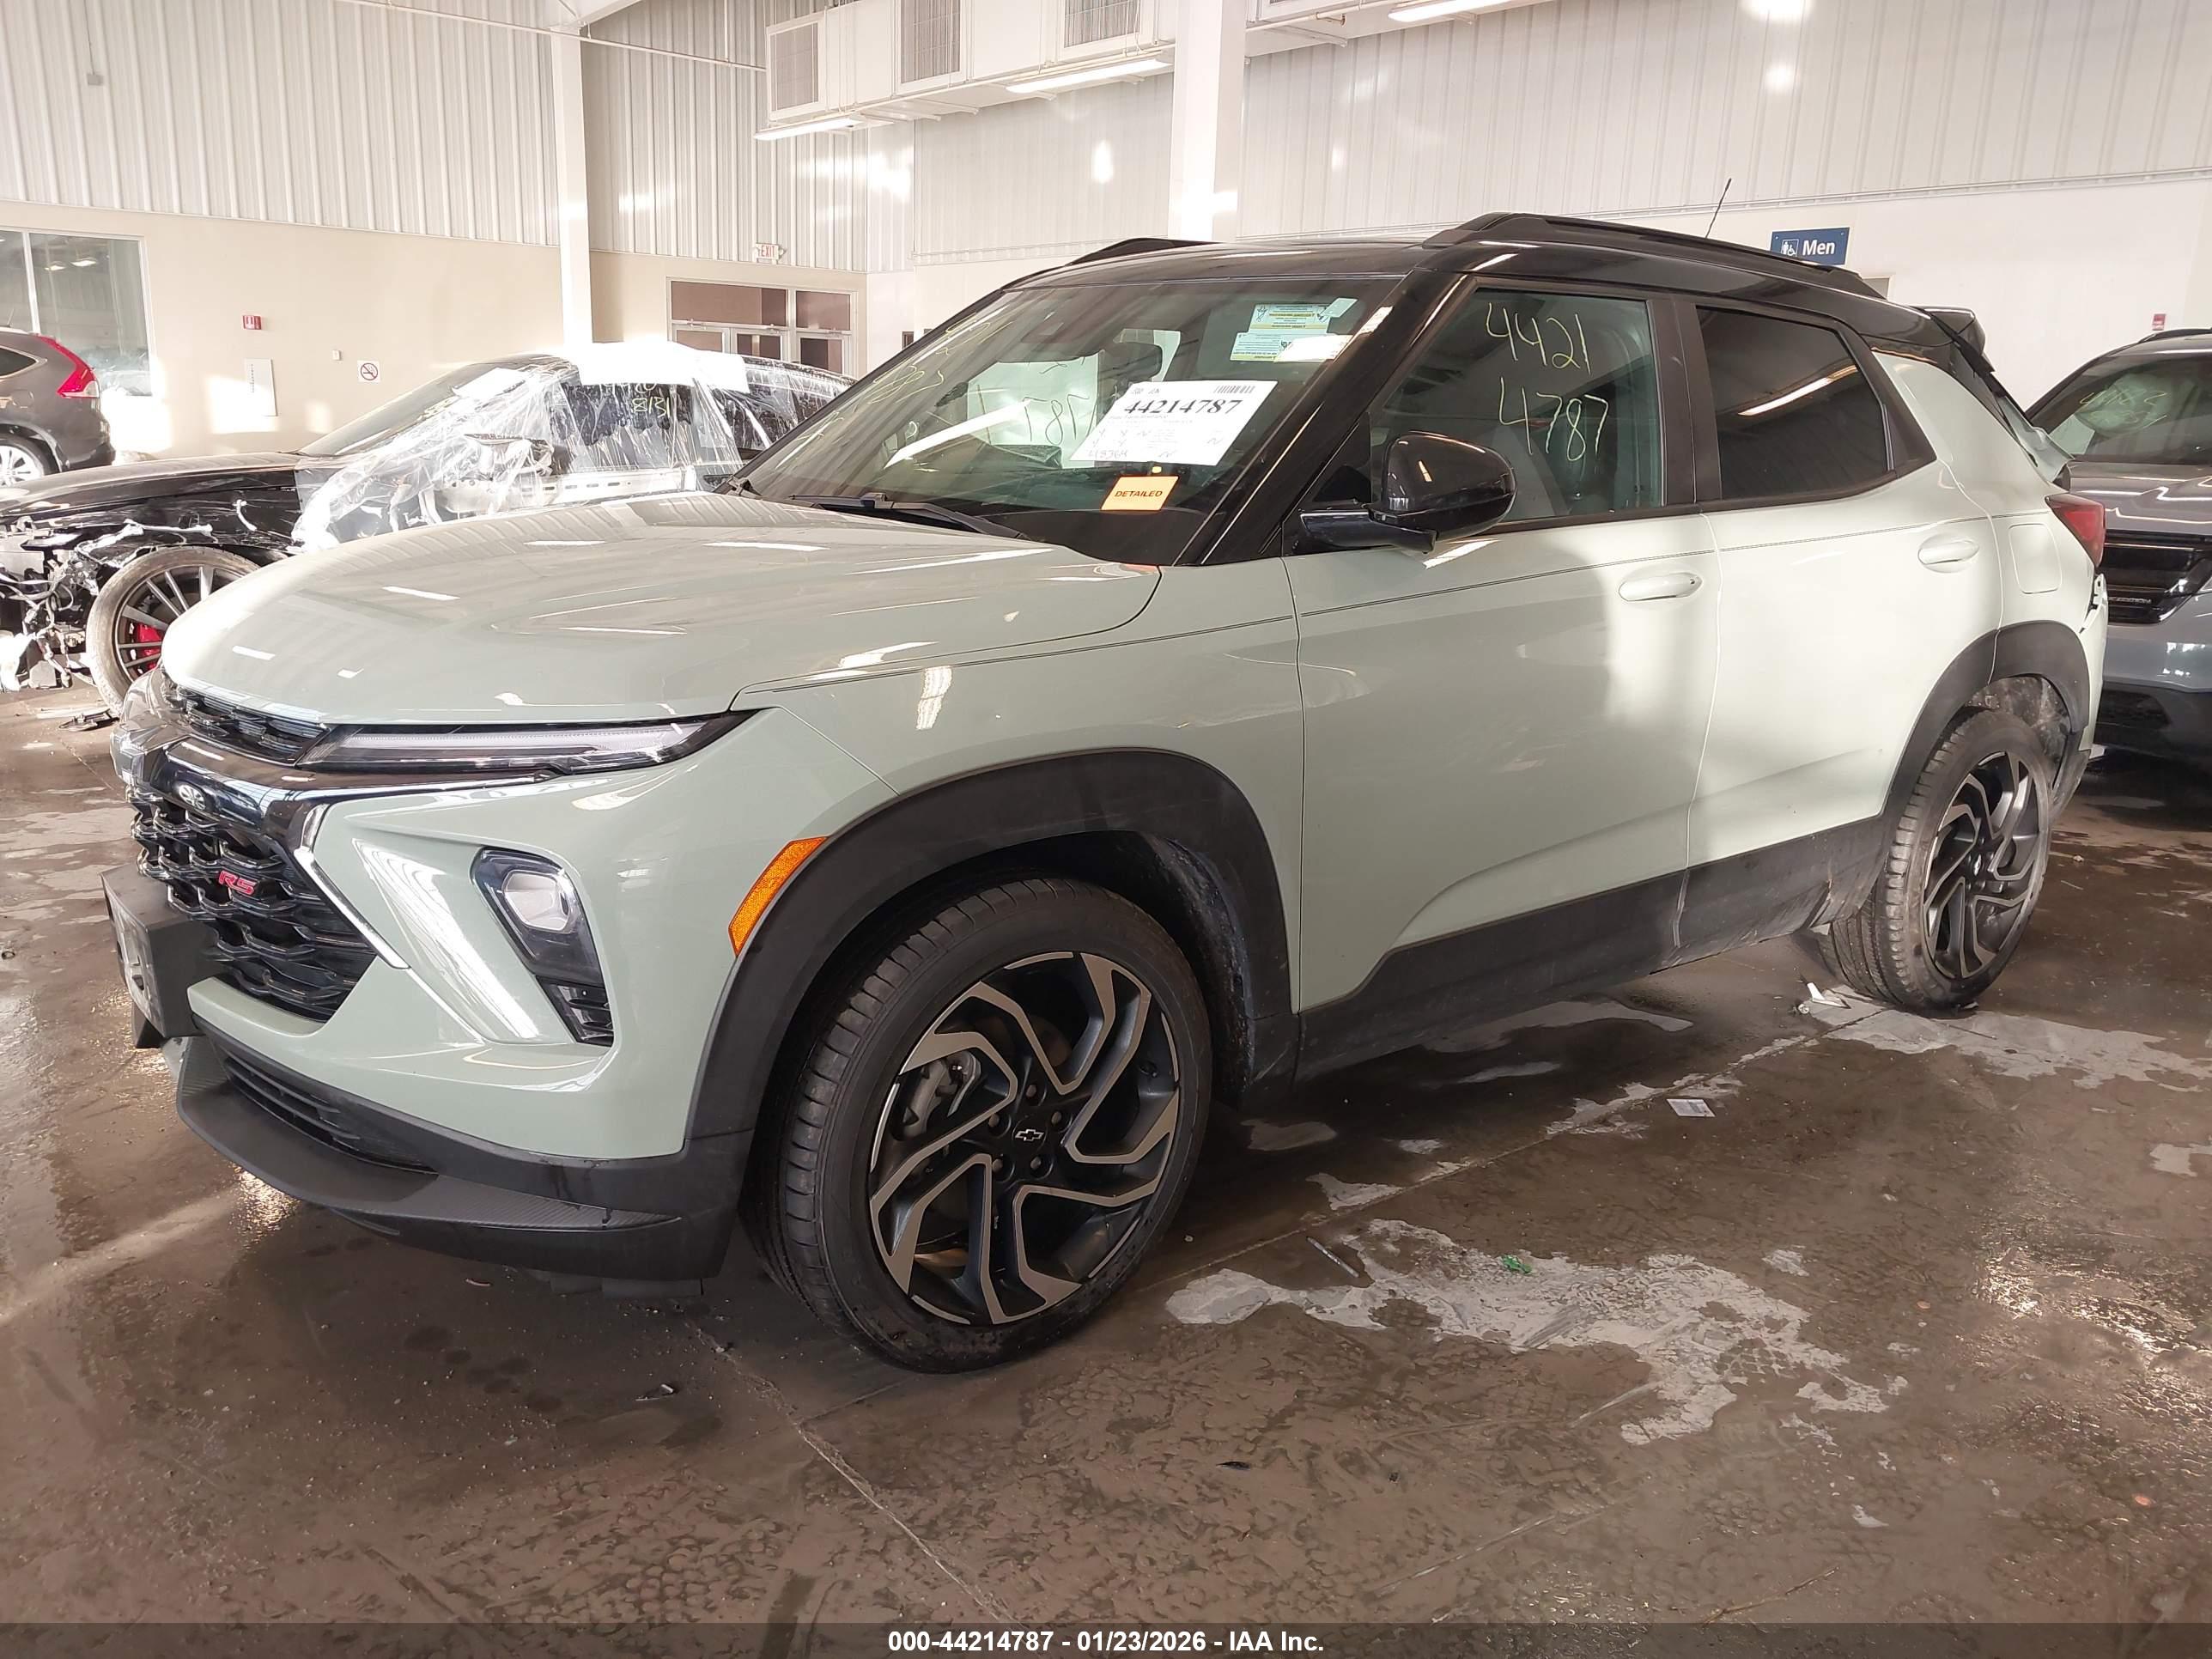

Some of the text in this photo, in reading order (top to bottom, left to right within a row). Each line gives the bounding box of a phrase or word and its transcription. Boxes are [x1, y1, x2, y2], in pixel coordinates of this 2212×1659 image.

[761, 245, 775, 257] EXIT
[1802, 240, 1836, 256] Men
[1486, 302, 1591, 375] 4421
[1124, 399, 1243, 414] 44214787
[1499, 376, 1608, 461] 4787
[219, 871, 257, 895] RS
